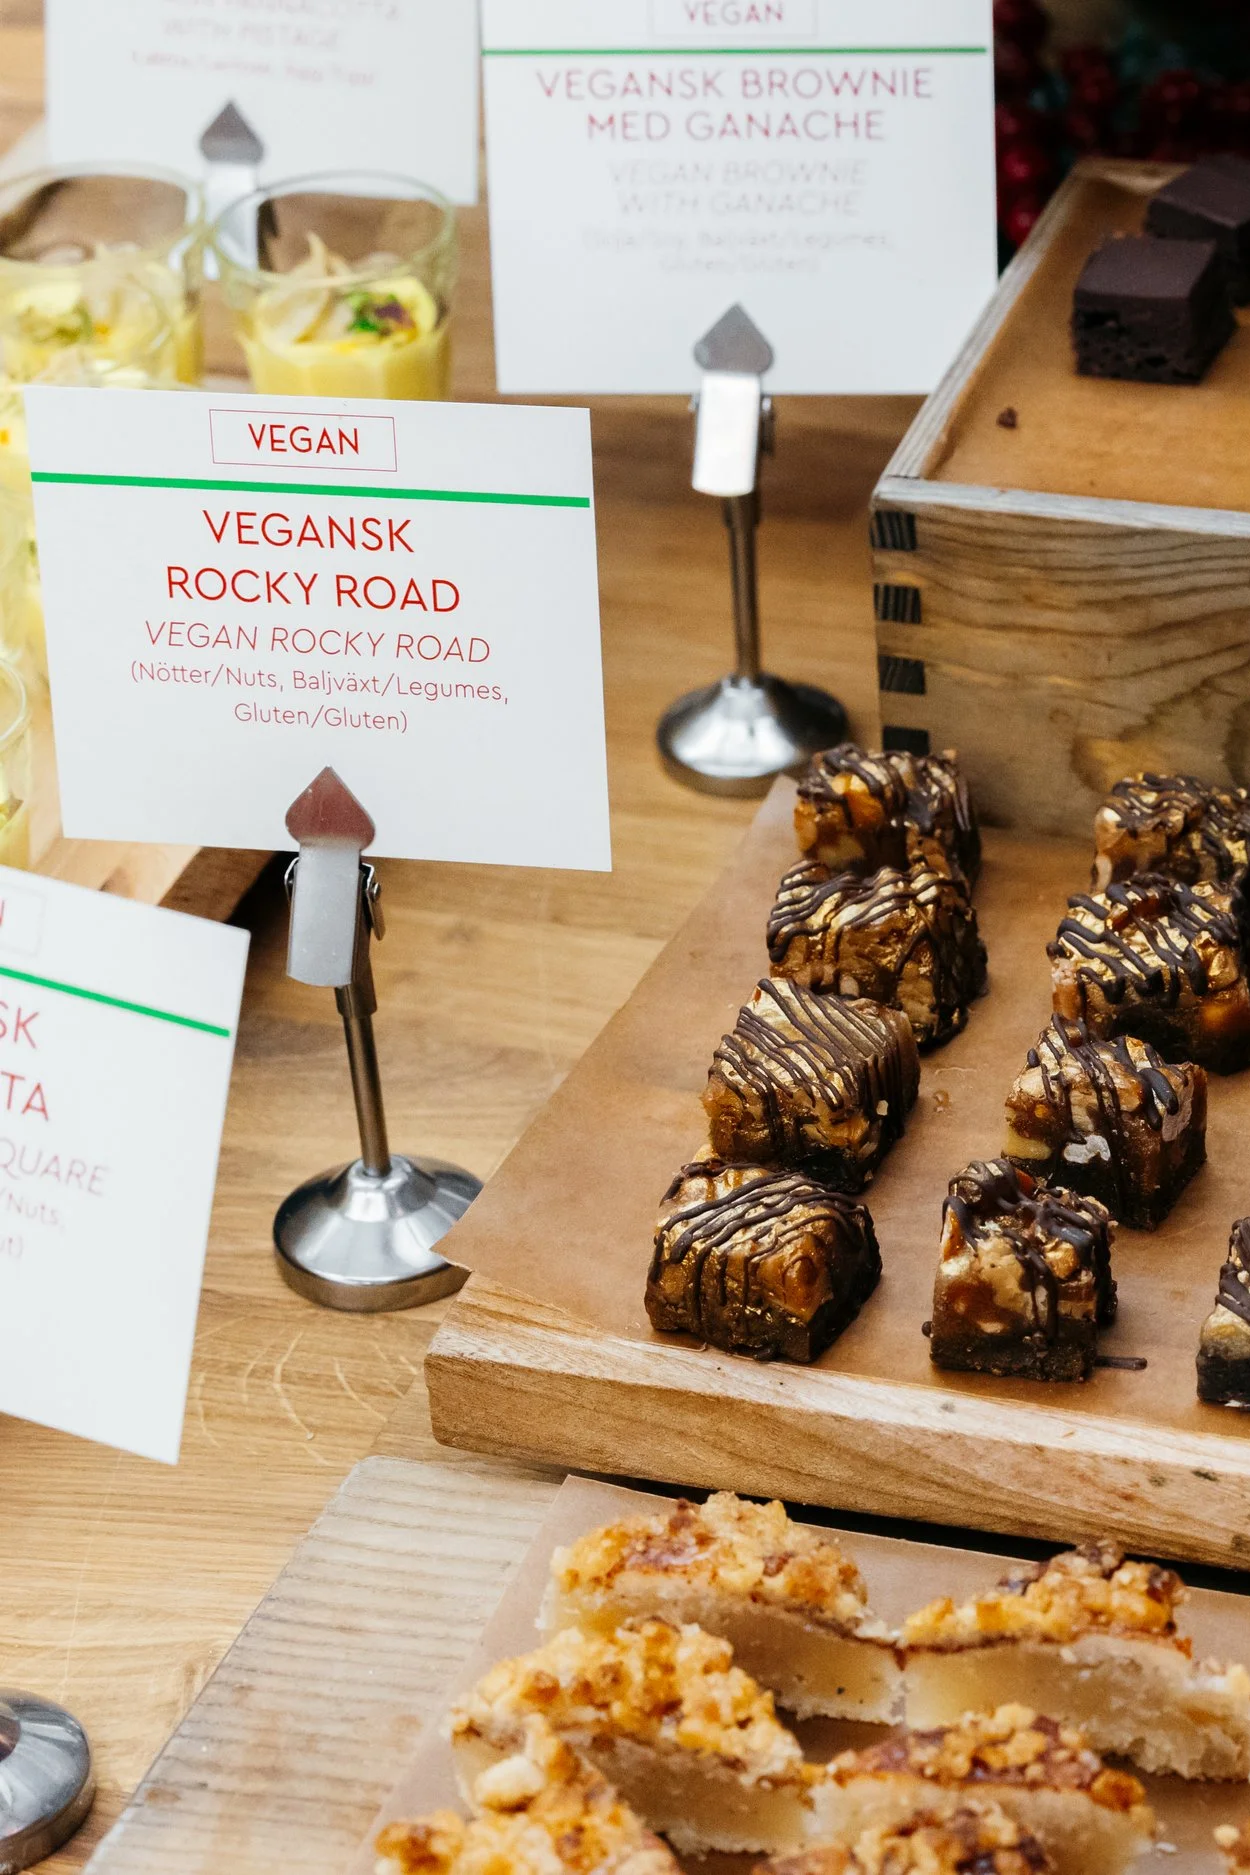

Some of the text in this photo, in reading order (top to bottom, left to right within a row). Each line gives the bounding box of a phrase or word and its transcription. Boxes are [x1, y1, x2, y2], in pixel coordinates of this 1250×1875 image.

[684, 0, 784, 26] VEGAN
[535, 67, 934, 101] VEGANSK BROWNIE
[586, 109, 885, 142] MED GANACHE
[608, 158, 868, 186] VEGAN BROWNIE
[618, 190, 862, 217] WITH GANACHE
[246, 422, 360, 456] VEGAN
[201, 508, 416, 554] VEGANSK
[165, 564, 461, 614] ROCKY ROAD
[144, 619, 492, 664] VEGAN ROCKY ROAD
[130, 660, 510, 706] (Nötter/Nuts, Baljväxt/Legumes,
[233, 701, 410, 735] Gluten/Gluten)
